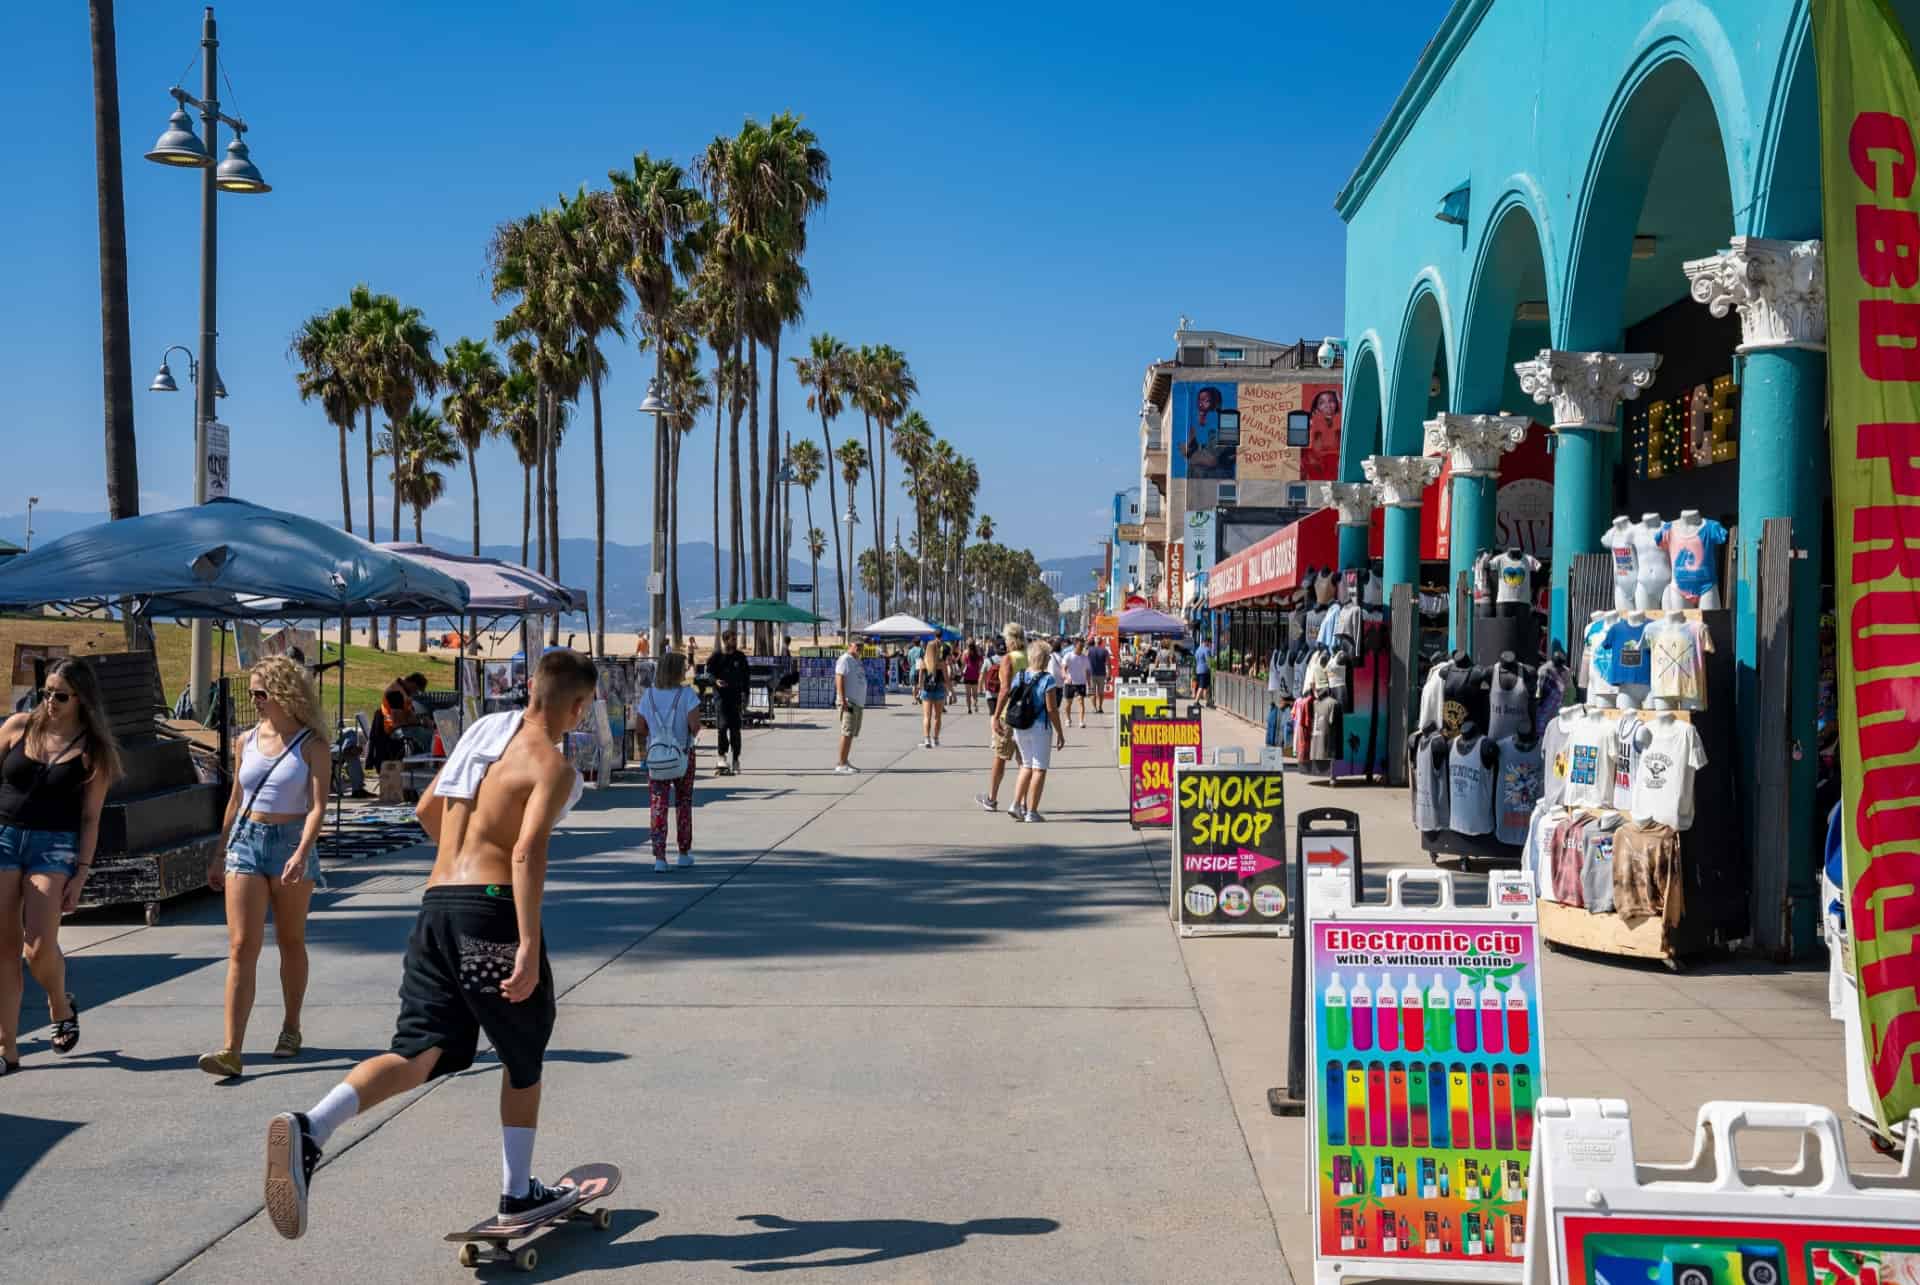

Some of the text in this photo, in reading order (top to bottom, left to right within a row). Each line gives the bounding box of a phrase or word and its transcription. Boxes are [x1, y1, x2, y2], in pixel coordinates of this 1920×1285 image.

[1848, 112, 1920, 381] CBD
[1244, 385, 1283, 400] MUSIC
[1252, 401, 1293, 414] PICKED
[1269, 415, 1283, 424] BY
[1242, 414, 1287, 443] HUMANS
[1248, 435, 1272, 448] NOT
[1244, 450, 1292, 464] ROBOTS
[1133, 724, 1200, 745] SKATEBOARDS
[1180, 776, 1283, 809] SMOKE
[1192, 812, 1273, 846] SHOP
[1185, 856, 1239, 871] INSIDE
[1326, 928, 1522, 954] Electronic cig
[1336, 953, 1512, 968] with & without nicotine
